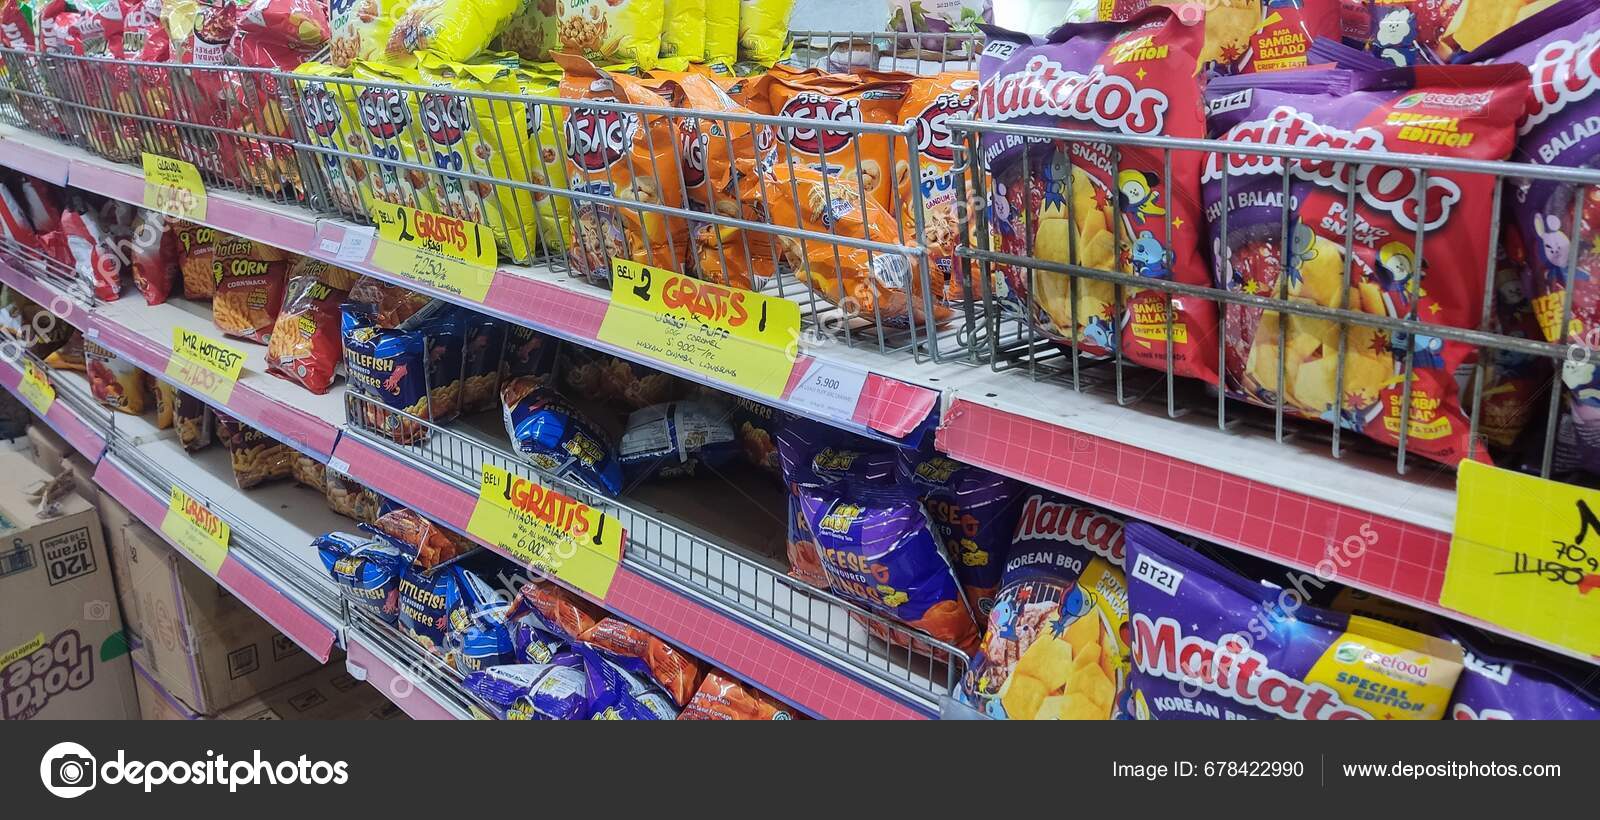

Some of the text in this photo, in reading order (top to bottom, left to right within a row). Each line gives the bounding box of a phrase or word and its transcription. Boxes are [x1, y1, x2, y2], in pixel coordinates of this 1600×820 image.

[1258, 33, 1306, 49] SAMBAL
[1259, 43, 1306, 60] BALADO
[1211, 93, 1247, 111] BT21
[1398, 126, 1474, 148] EDITION
[397, 206, 415, 242] 2
[414, 209, 468, 252] GRATIS
[231, 259, 269, 276] CORN
[616, 264, 768, 333] BELI 2 GRATIS 1
[199, 341, 242, 369] HOTTEST
[816, 375, 840, 390] 5.900
[483, 471, 500, 487] BELI
[511, 478, 590, 537] GRATIS
[508, 507, 539, 528] MIAOW
[47, 538, 89, 561] gram
[50, 553, 92, 581] 120
[1006, 552, 1083, 576] KOREAN BBQ
[1138, 560, 1175, 591] BT21
[1363, 650, 1428, 678] aefood
[1336, 671, 1408, 700] SPECIAL
[1353, 690, 1425, 712] EDITION
